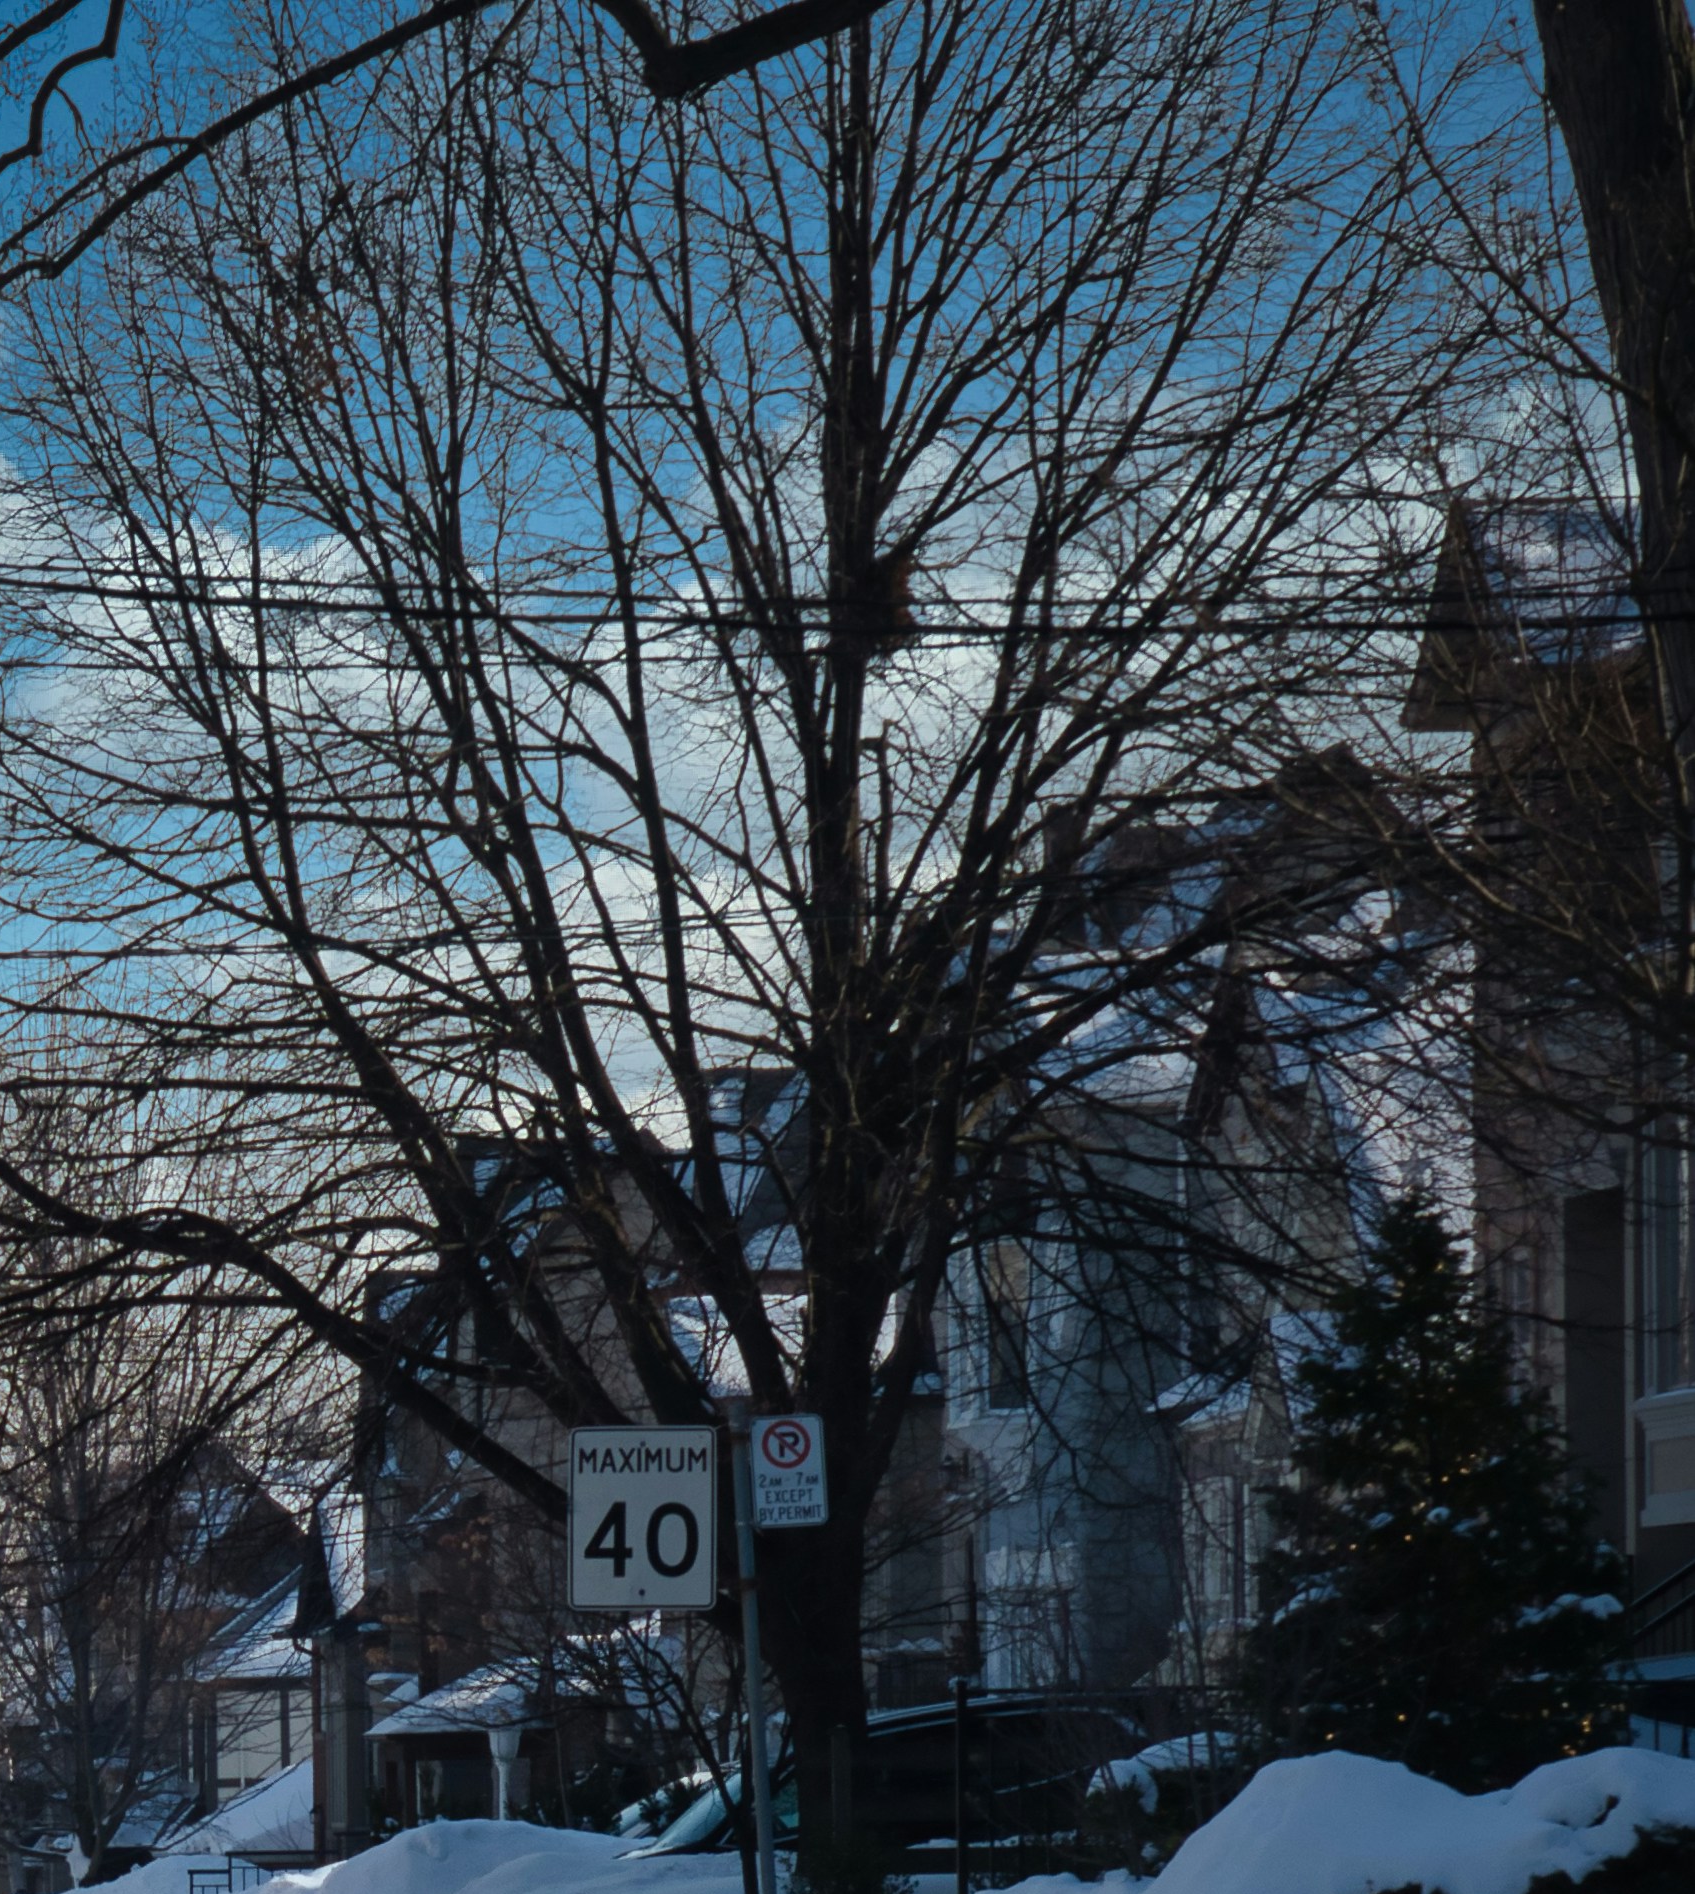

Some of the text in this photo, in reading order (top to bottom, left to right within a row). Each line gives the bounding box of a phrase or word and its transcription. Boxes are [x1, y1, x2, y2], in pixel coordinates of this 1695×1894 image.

[578, 1446, 707, 1474] MAXIMUM
[765, 1487, 814, 1504] EXCEPT
[759, 1504, 823, 1522] BY PERMIT
[583, 1499, 699, 1578] 40
